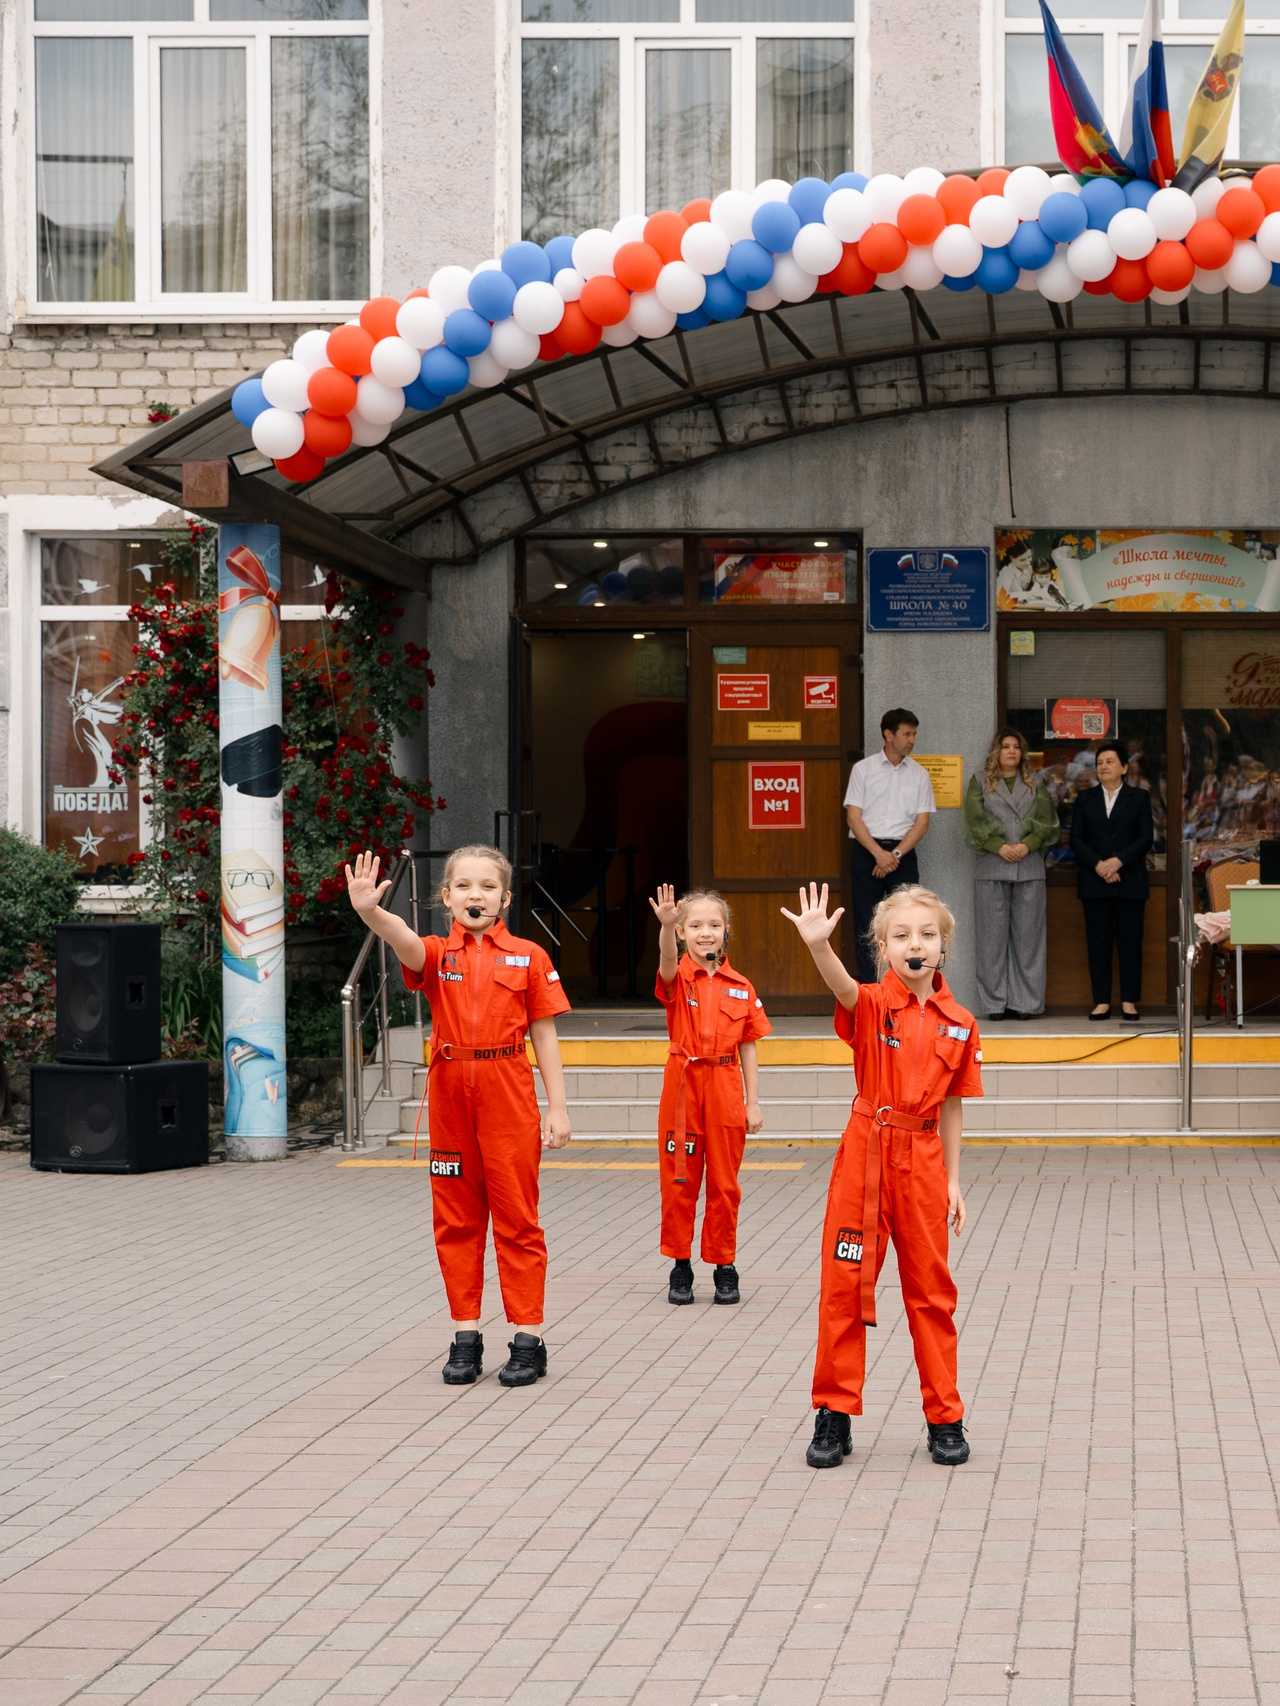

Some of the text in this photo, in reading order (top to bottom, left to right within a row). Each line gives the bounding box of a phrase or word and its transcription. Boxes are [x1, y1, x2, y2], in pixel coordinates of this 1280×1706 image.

[1112, 548, 1228, 567] «Школа мечты,
[763, 571, 840, 579] ИЗБИРАТЕЛЬНАЯ
[1106, 569, 1246, 590] надежды и свершений!»
[890, 601, 967, 610] ШКОЛА № 40
[1232, 652, 1262, 688] 9
[754, 778, 800, 793] ВХОД
[54, 793, 128, 814] ПОБЕДА!
[764, 799, 789, 812] №1
[430, 1152, 460, 1162] FASHION
[431, 1160, 460, 1176] CRFT
